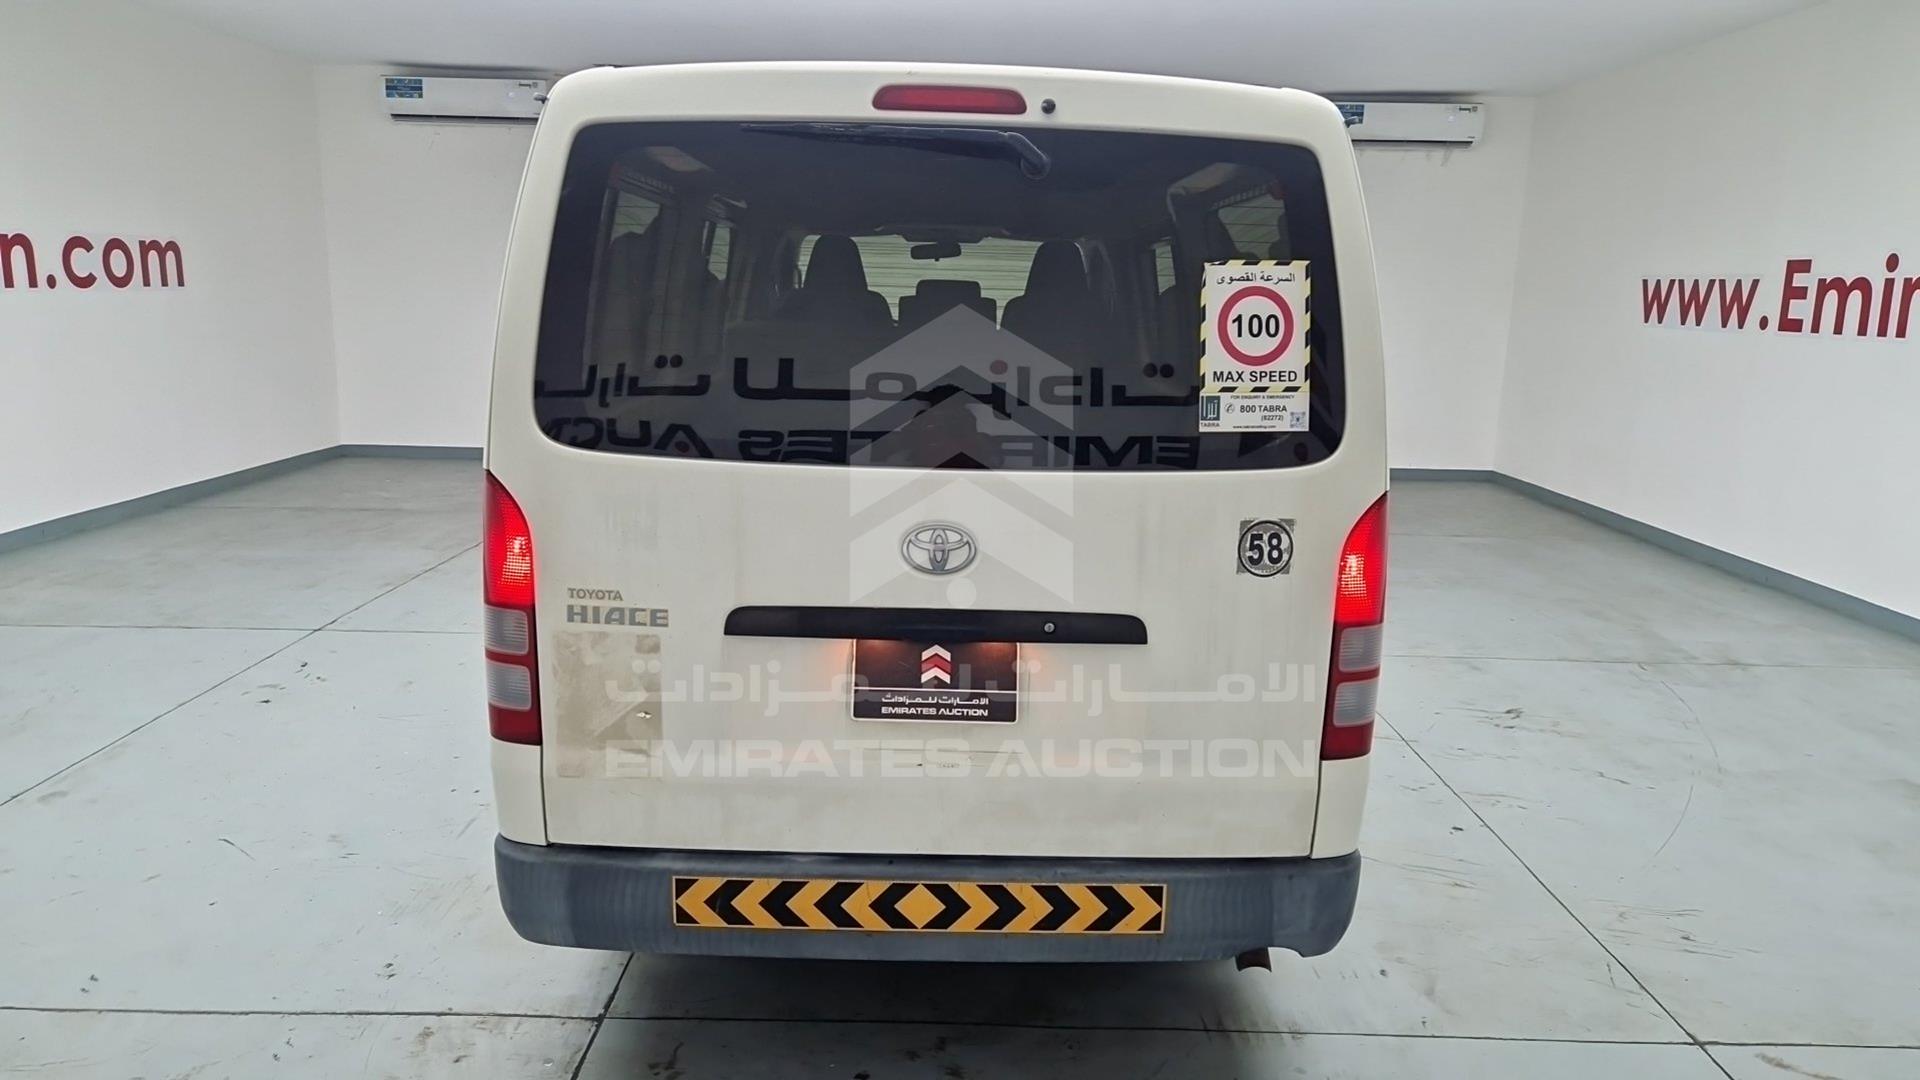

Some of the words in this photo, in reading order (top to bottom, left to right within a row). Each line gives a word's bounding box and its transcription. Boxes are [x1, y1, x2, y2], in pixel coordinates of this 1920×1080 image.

[0, 233, 185, 289] n.com
[1216, 272, 1257, 285] القصوى
[1259, 271, 1295, 285] السرعة
[1232, 314, 1280, 338] 100
[1213, 371, 1245, 383] MAX
[1249, 371, 1297, 383] SPEED
[1240, 404, 1257, 413] 800
[1258, 404, 1287, 413] TABRA
[1248, 532, 1283, 566] 58
[567, 587, 624, 602] TOYOTA
[567, 604, 669, 627] HIACE
[881, 706, 937, 715] EMIRATES
[938, 708, 989, 717] AUCTION
